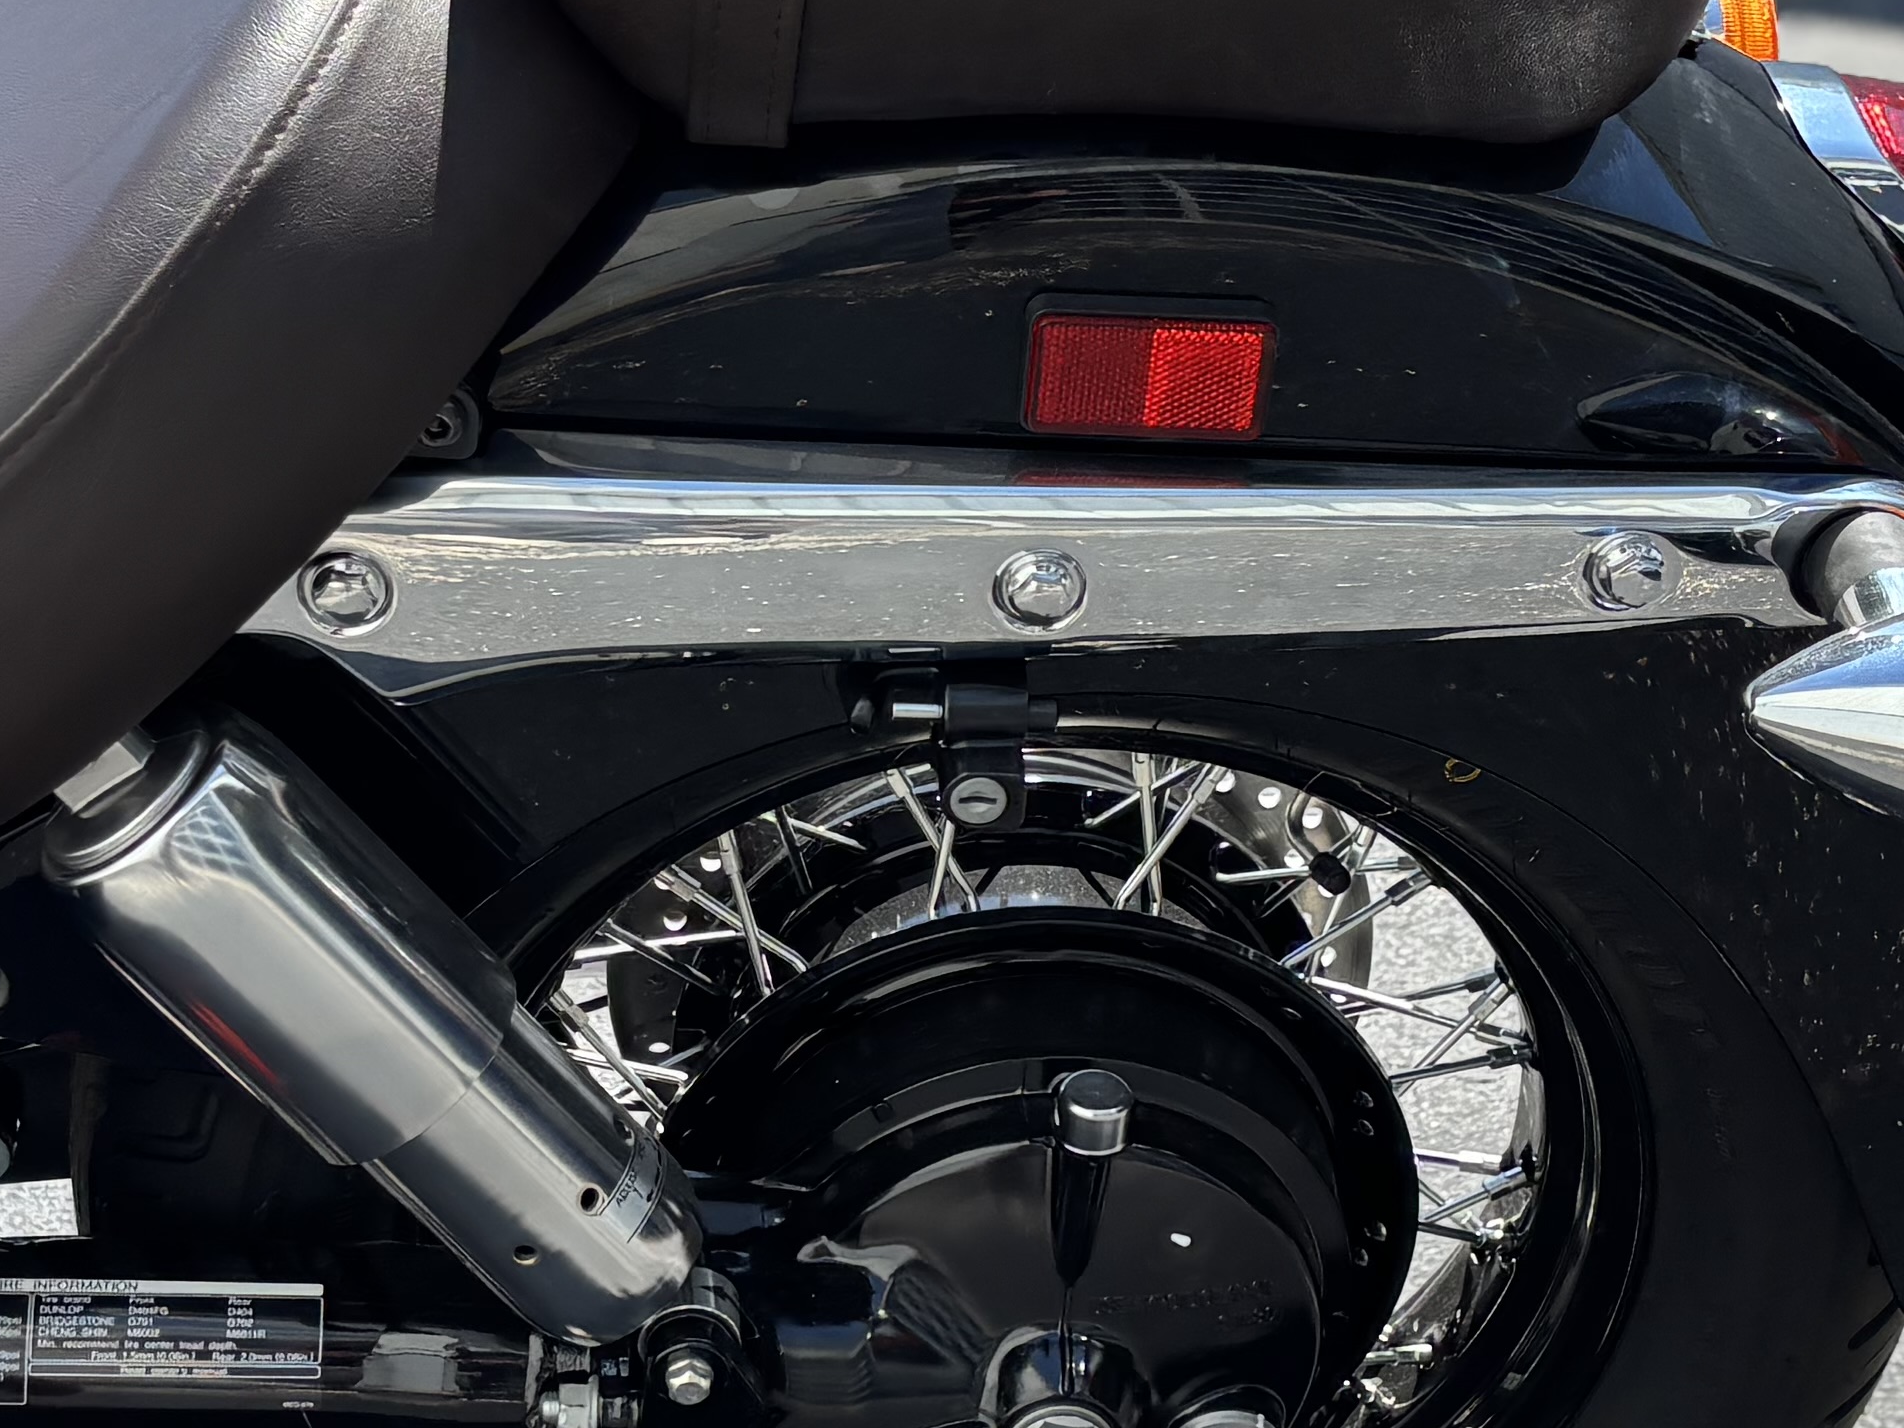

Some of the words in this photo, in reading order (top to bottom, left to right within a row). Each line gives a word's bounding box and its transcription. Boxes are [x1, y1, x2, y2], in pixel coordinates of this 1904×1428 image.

[33, 1279, 139, 1292] INFORMATION
[39, 1305, 85, 1314] DUNLOP
[38, 1316, 116, 1326] BRIDGESTONE
[38, 1327, 77, 1337] CHENG
[62, 1339, 120, 1349] recommend
[143, 1341, 175, 1350] center
